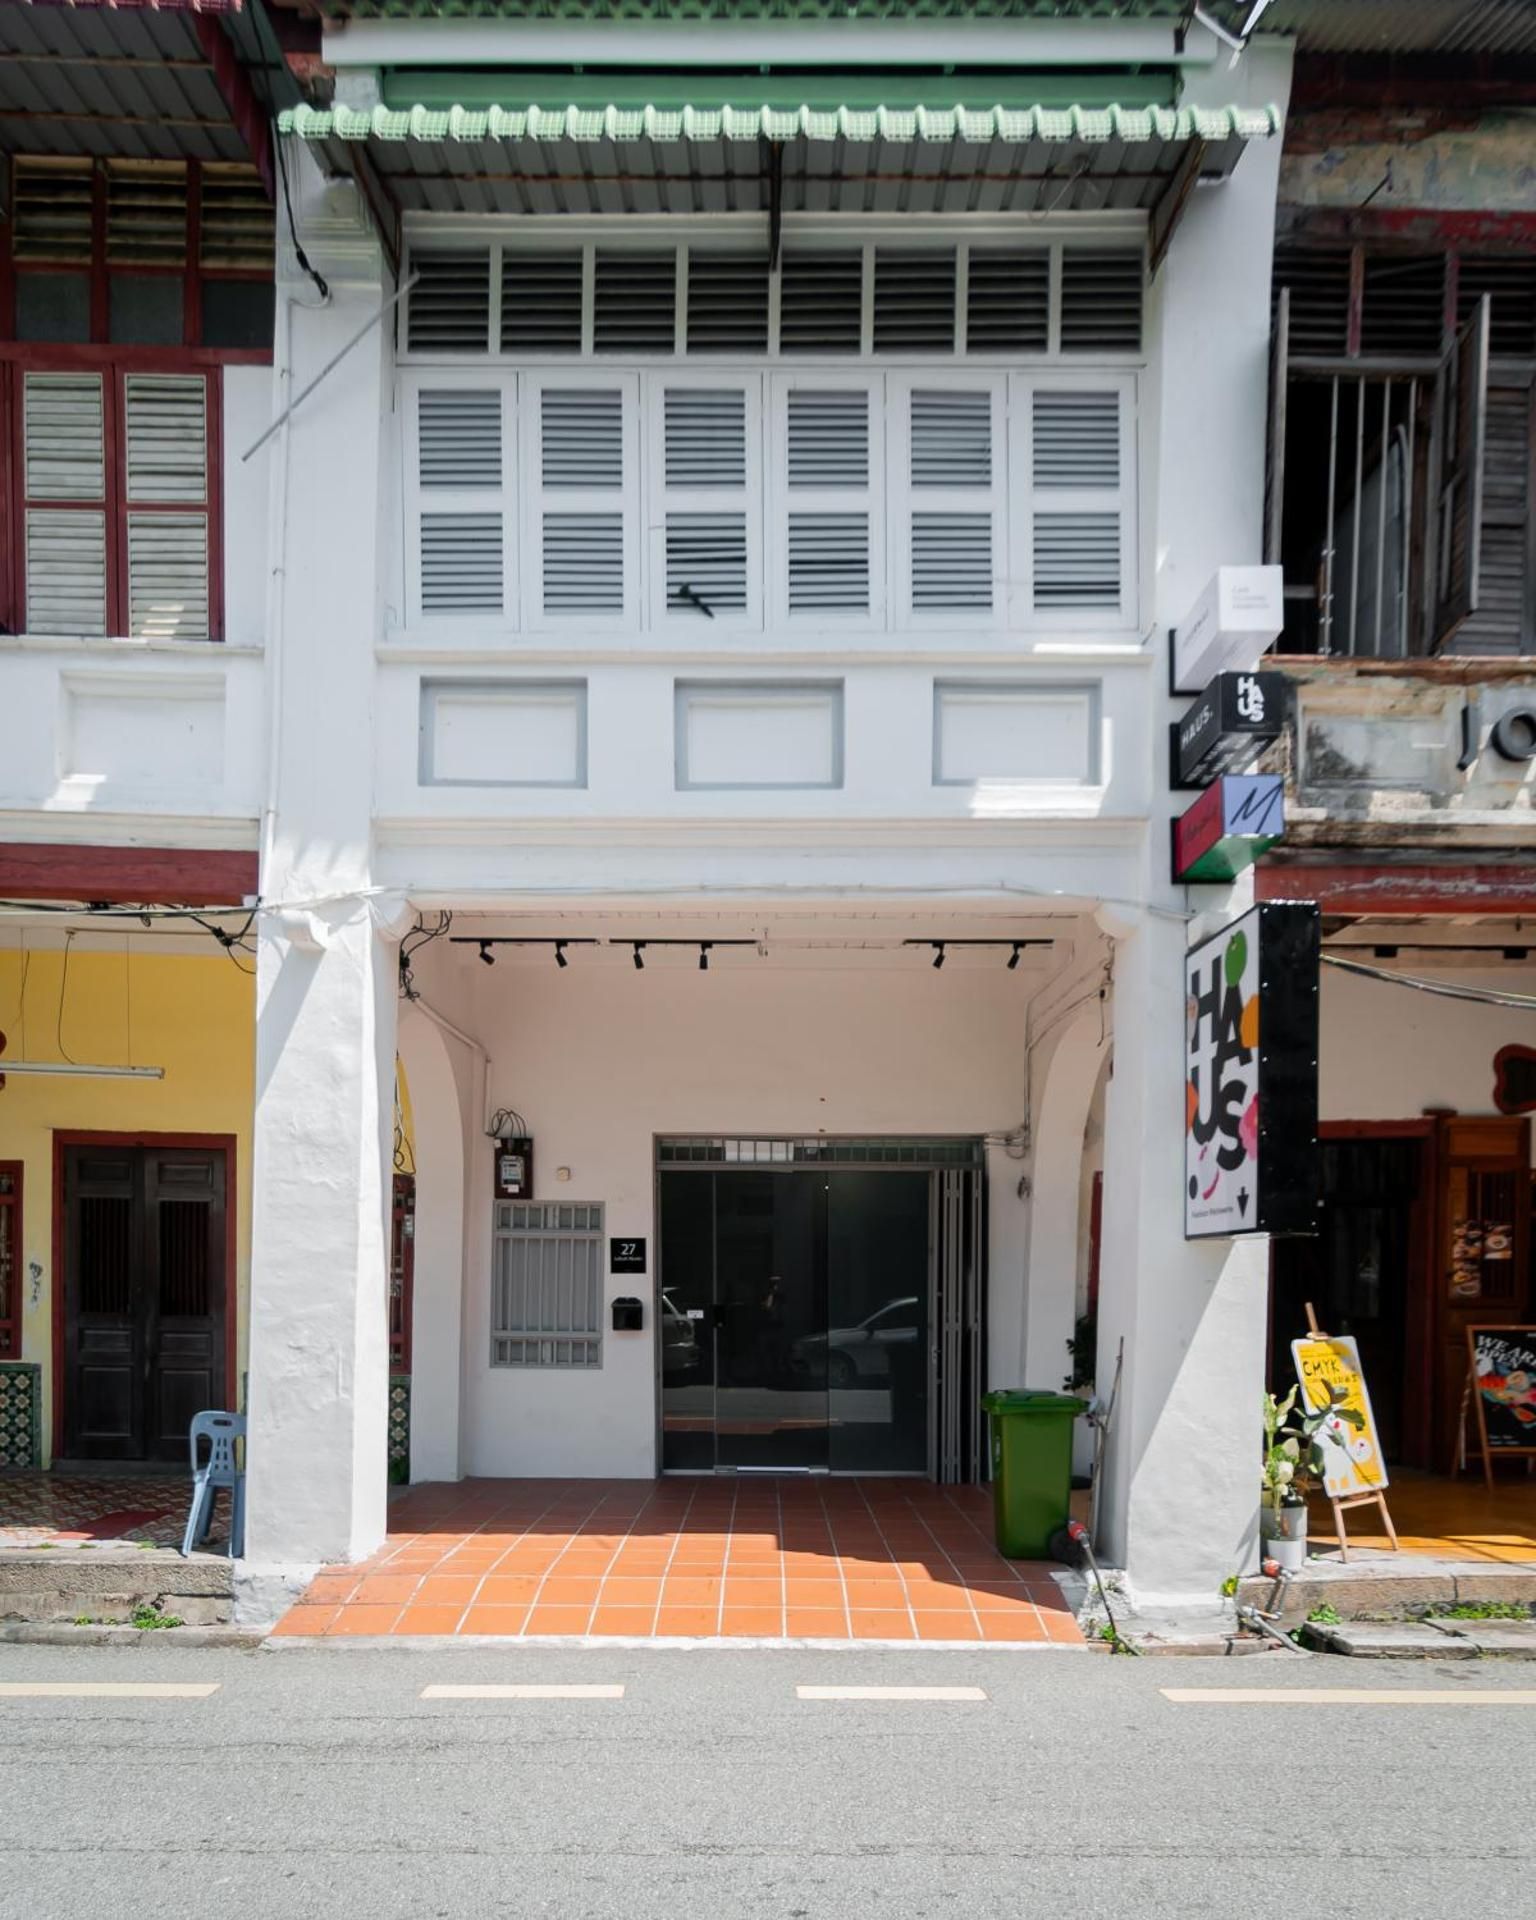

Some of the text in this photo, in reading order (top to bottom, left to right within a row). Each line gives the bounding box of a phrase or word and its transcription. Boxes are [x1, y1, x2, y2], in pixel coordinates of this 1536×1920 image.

[620, 1243, 636, 1255] 27
[1478, 1335, 1509, 1353] WE
[1475, 1347, 1521, 1369] OPEN
[1303, 1360, 1341, 1377] CMYK
